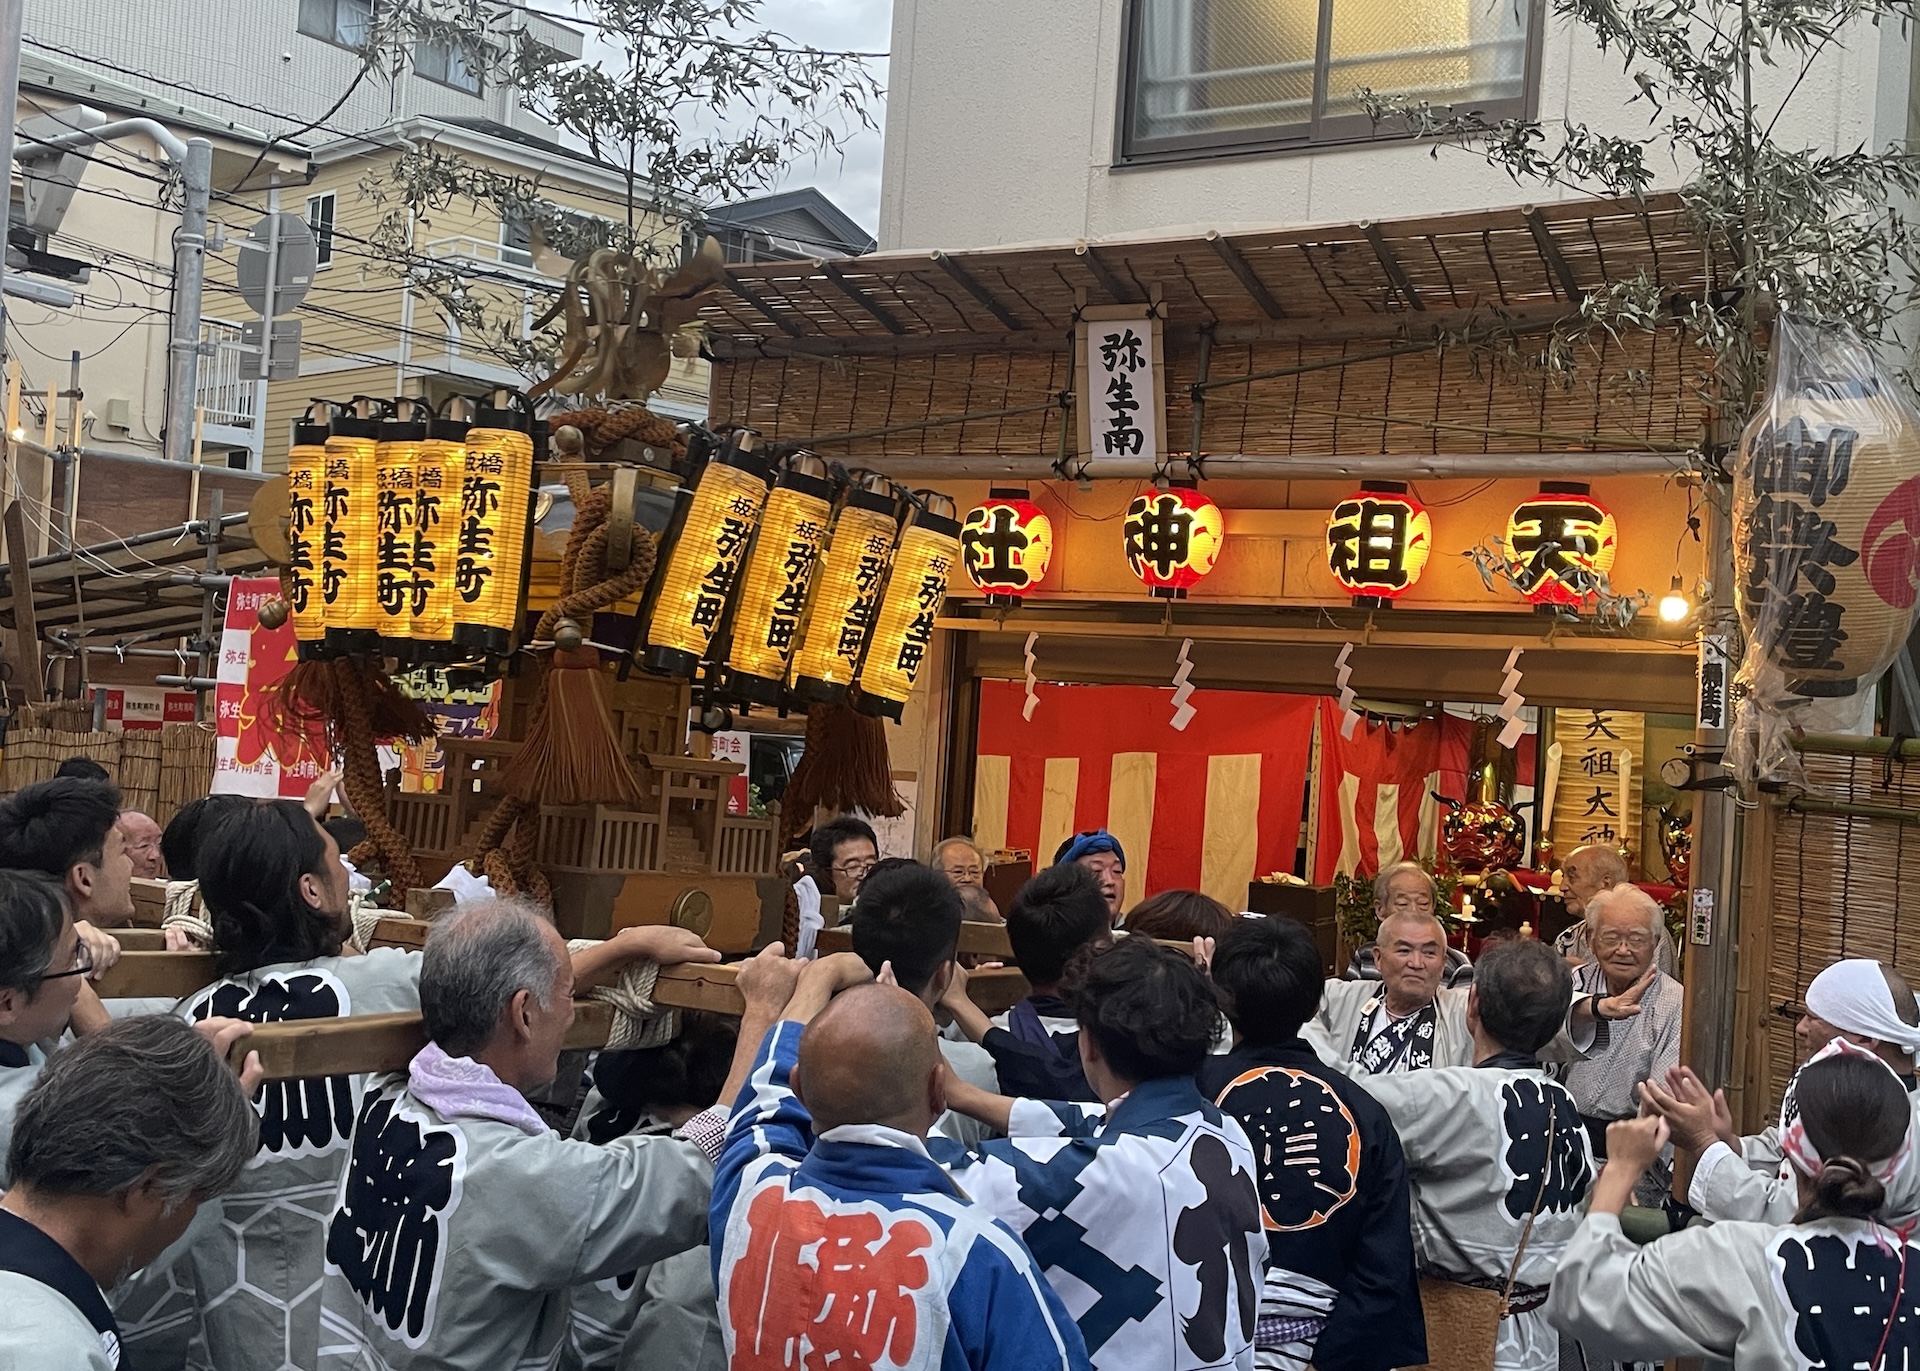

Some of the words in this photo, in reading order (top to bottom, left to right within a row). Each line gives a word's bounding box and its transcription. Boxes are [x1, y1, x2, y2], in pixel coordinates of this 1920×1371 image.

[1099, 328, 1146, 456] 弥生南
[291, 470, 313, 490] 橋
[325, 458, 349, 480] 橋
[417, 467, 443, 489] 橋
[728, 495, 762, 518] 板
[793, 520, 823, 542] 板
[1124, 498, 1195, 578] 神
[865, 534, 892, 556] 板
[962, 507, 1029, 586] 社
[1328, 500, 1409, 587] 祖
[1511, 504, 1604, 593] 天
[927, 555, 952, 575] 板
